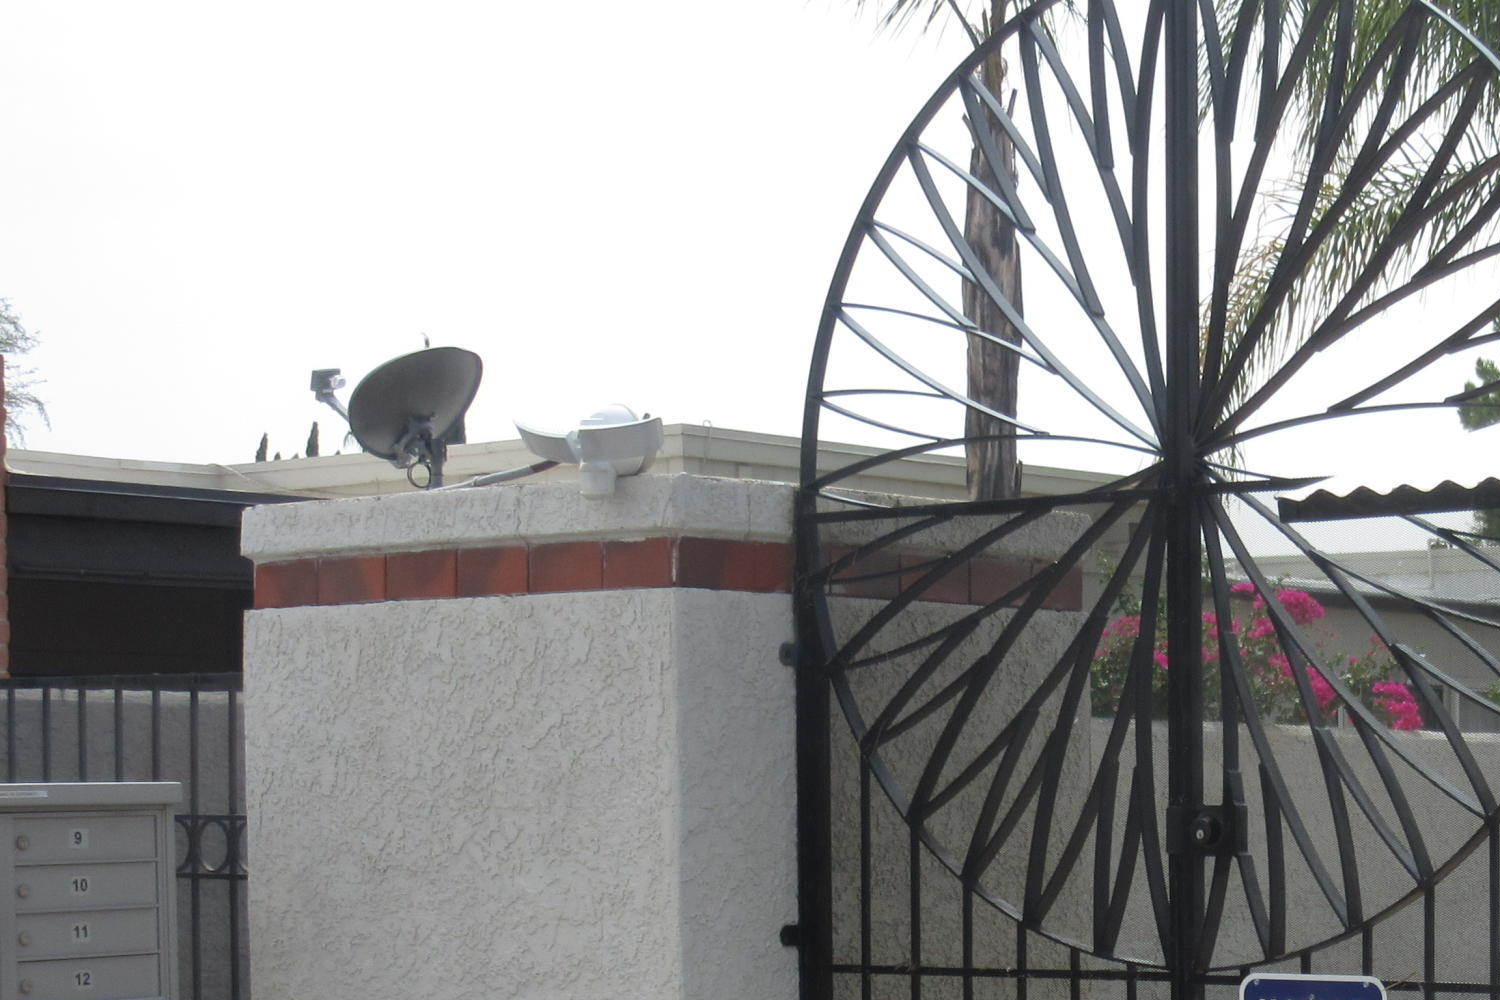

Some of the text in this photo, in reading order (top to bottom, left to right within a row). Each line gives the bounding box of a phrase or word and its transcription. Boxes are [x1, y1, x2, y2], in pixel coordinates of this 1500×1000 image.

[73, 831, 82, 844] 9
[72, 878, 88, 892] 10
[73, 925, 88, 938] 11
[75, 972, 91, 986] 12
